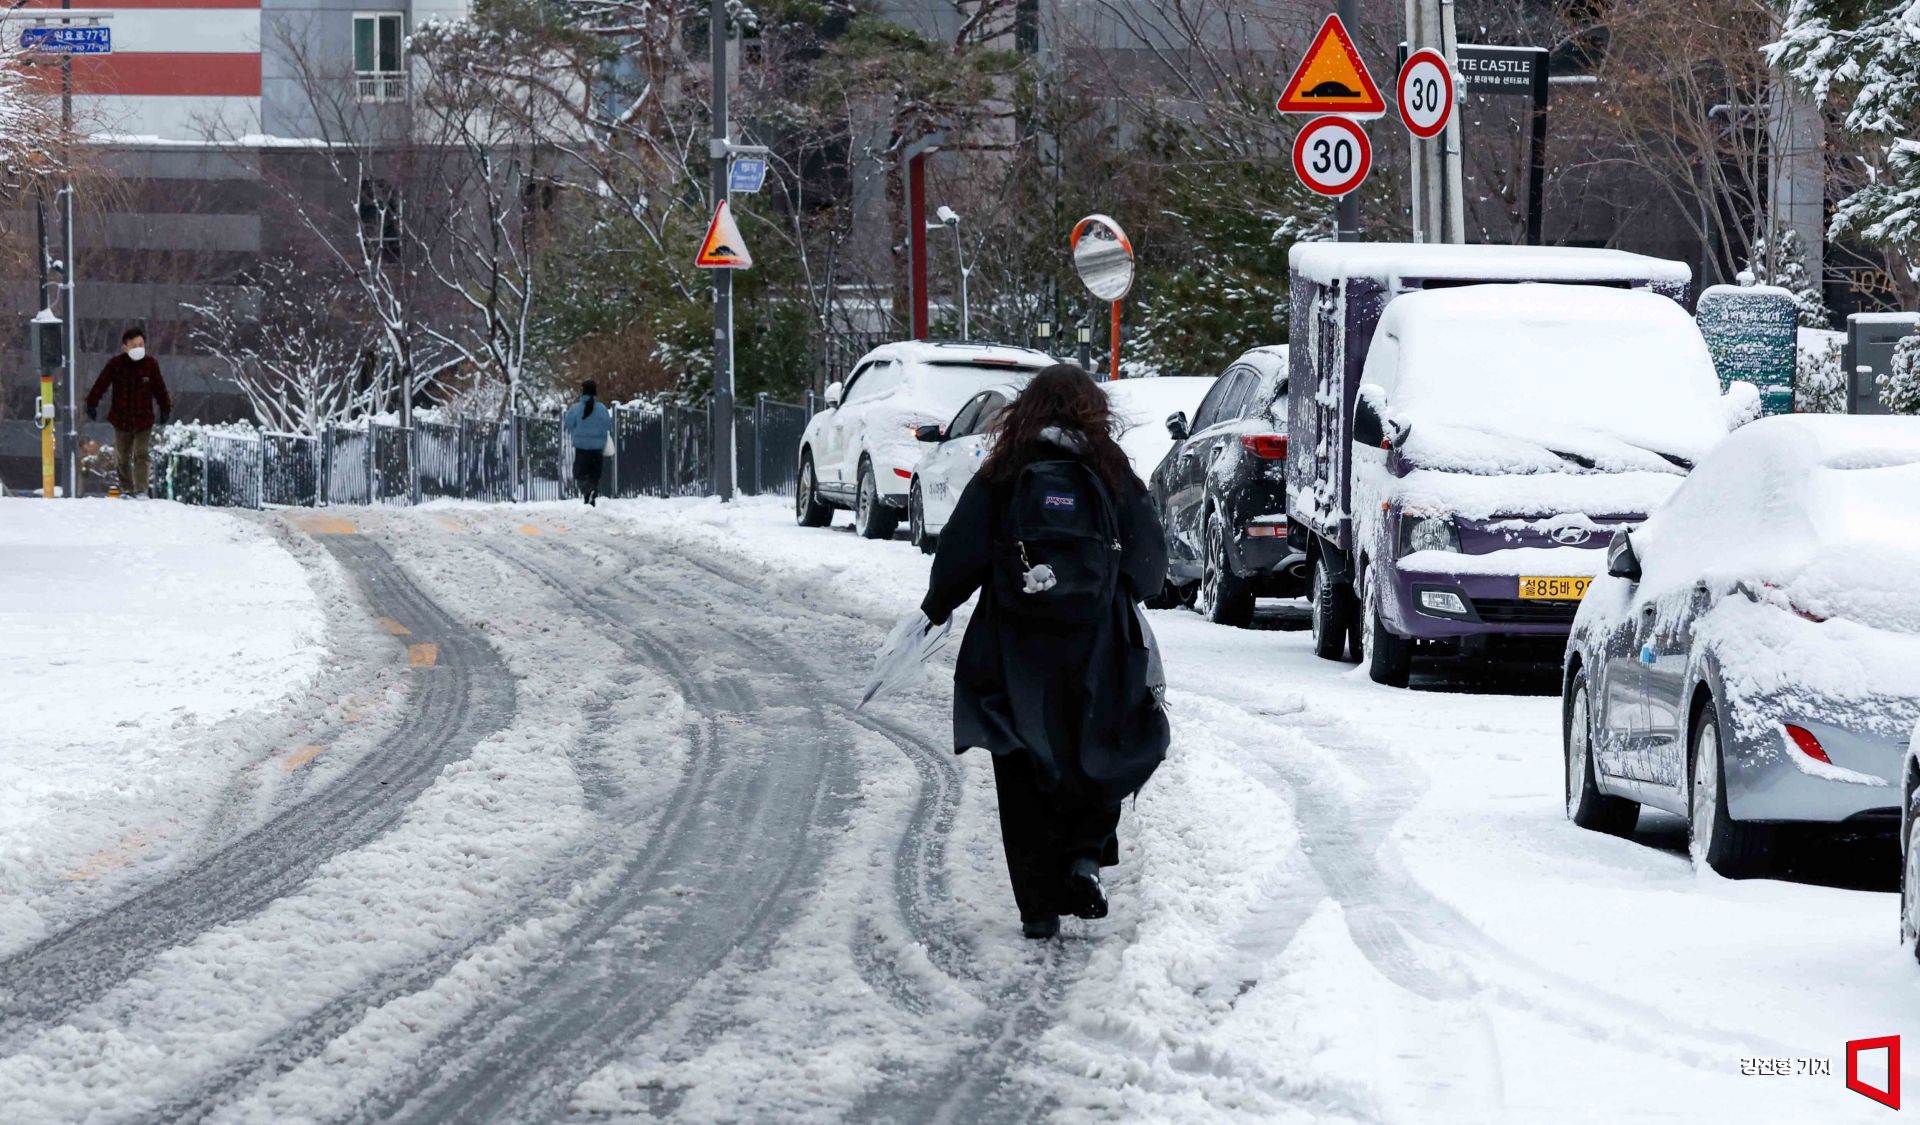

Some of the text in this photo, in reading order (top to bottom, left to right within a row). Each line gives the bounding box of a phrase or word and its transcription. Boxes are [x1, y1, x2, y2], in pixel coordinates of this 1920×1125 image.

[54, 30, 108, 42] 원효로77길
[1458, 59, 1530, 73] TE CASTLE
[1474, 75, 1501, 84] 롯데캐슬
[1503, 76, 1530, 85] 센터포레
[1412, 77, 1438, 112] 30
[1312, 139, 1353, 174] 30
[1574, 580, 1592, 597] 9
